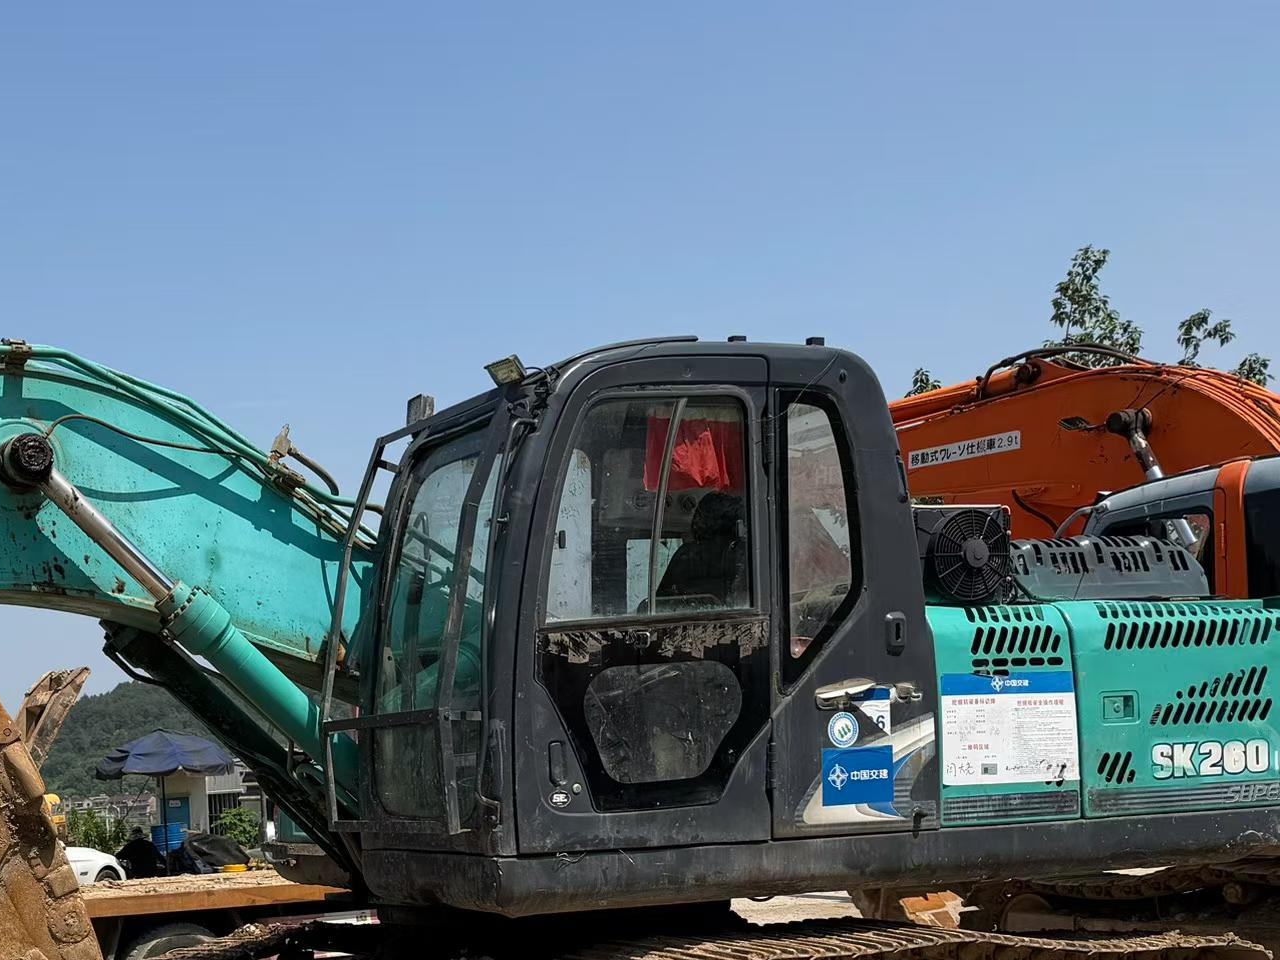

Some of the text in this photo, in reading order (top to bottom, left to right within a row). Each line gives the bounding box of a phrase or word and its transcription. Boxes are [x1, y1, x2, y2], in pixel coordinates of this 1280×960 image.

[1151, 738, 1270, 779] SK260
[850, 768, 889, 780] 中国交建
